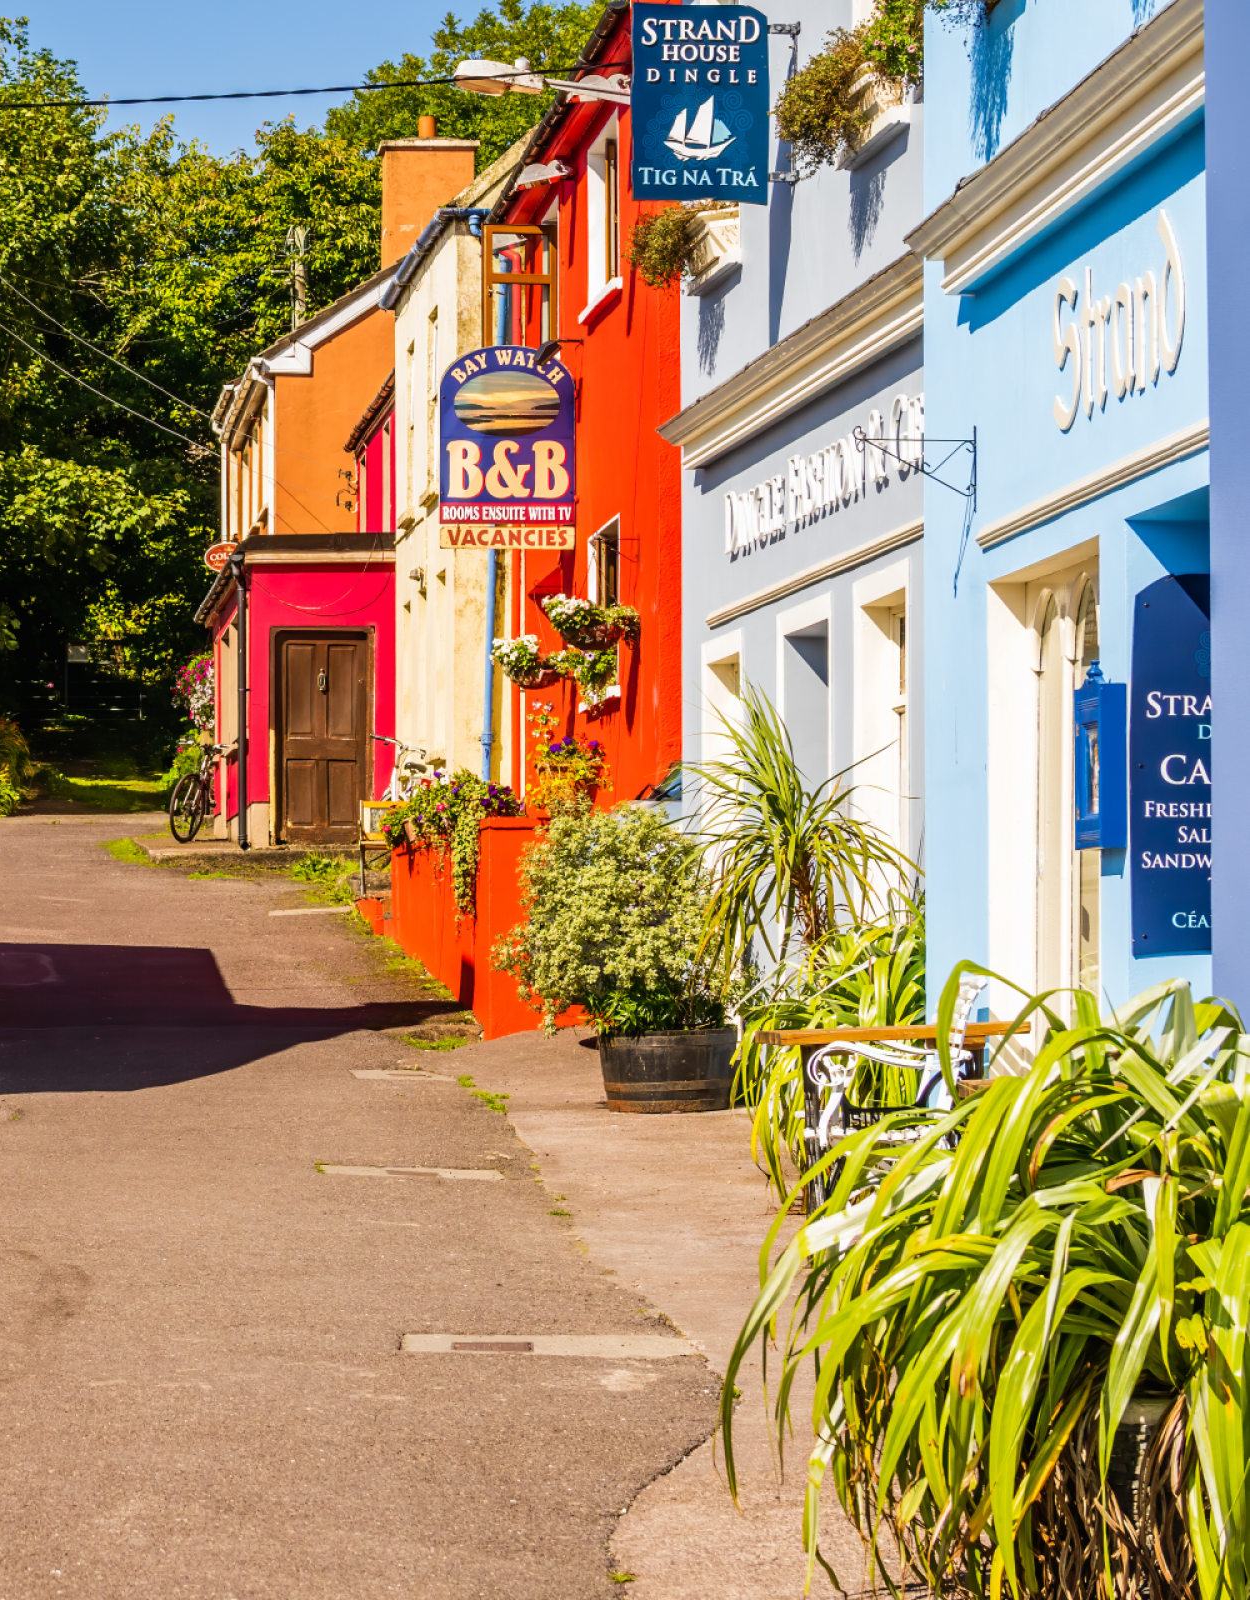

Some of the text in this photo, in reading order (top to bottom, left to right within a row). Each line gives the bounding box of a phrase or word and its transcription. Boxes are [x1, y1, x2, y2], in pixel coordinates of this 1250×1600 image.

[641, 16, 761, 46] STRAND
[661, 44, 741, 62] HOUSE
[646, 68, 757, 84] DINGLE
[1053, 208, 1185, 431] Strand
[451, 352, 487, 384] BAY
[446, 440, 571, 499] B&B
[724, 475, 786, 556] DINGLE
[787, 428, 866, 524] FASHION
[442, 505, 572, 521] ROOMS ENSUITE WITH TV
[447, 529, 568, 547] VACANCIES
[210, 552, 232, 561] COL
[1171, 910, 1213, 928] CÉA
